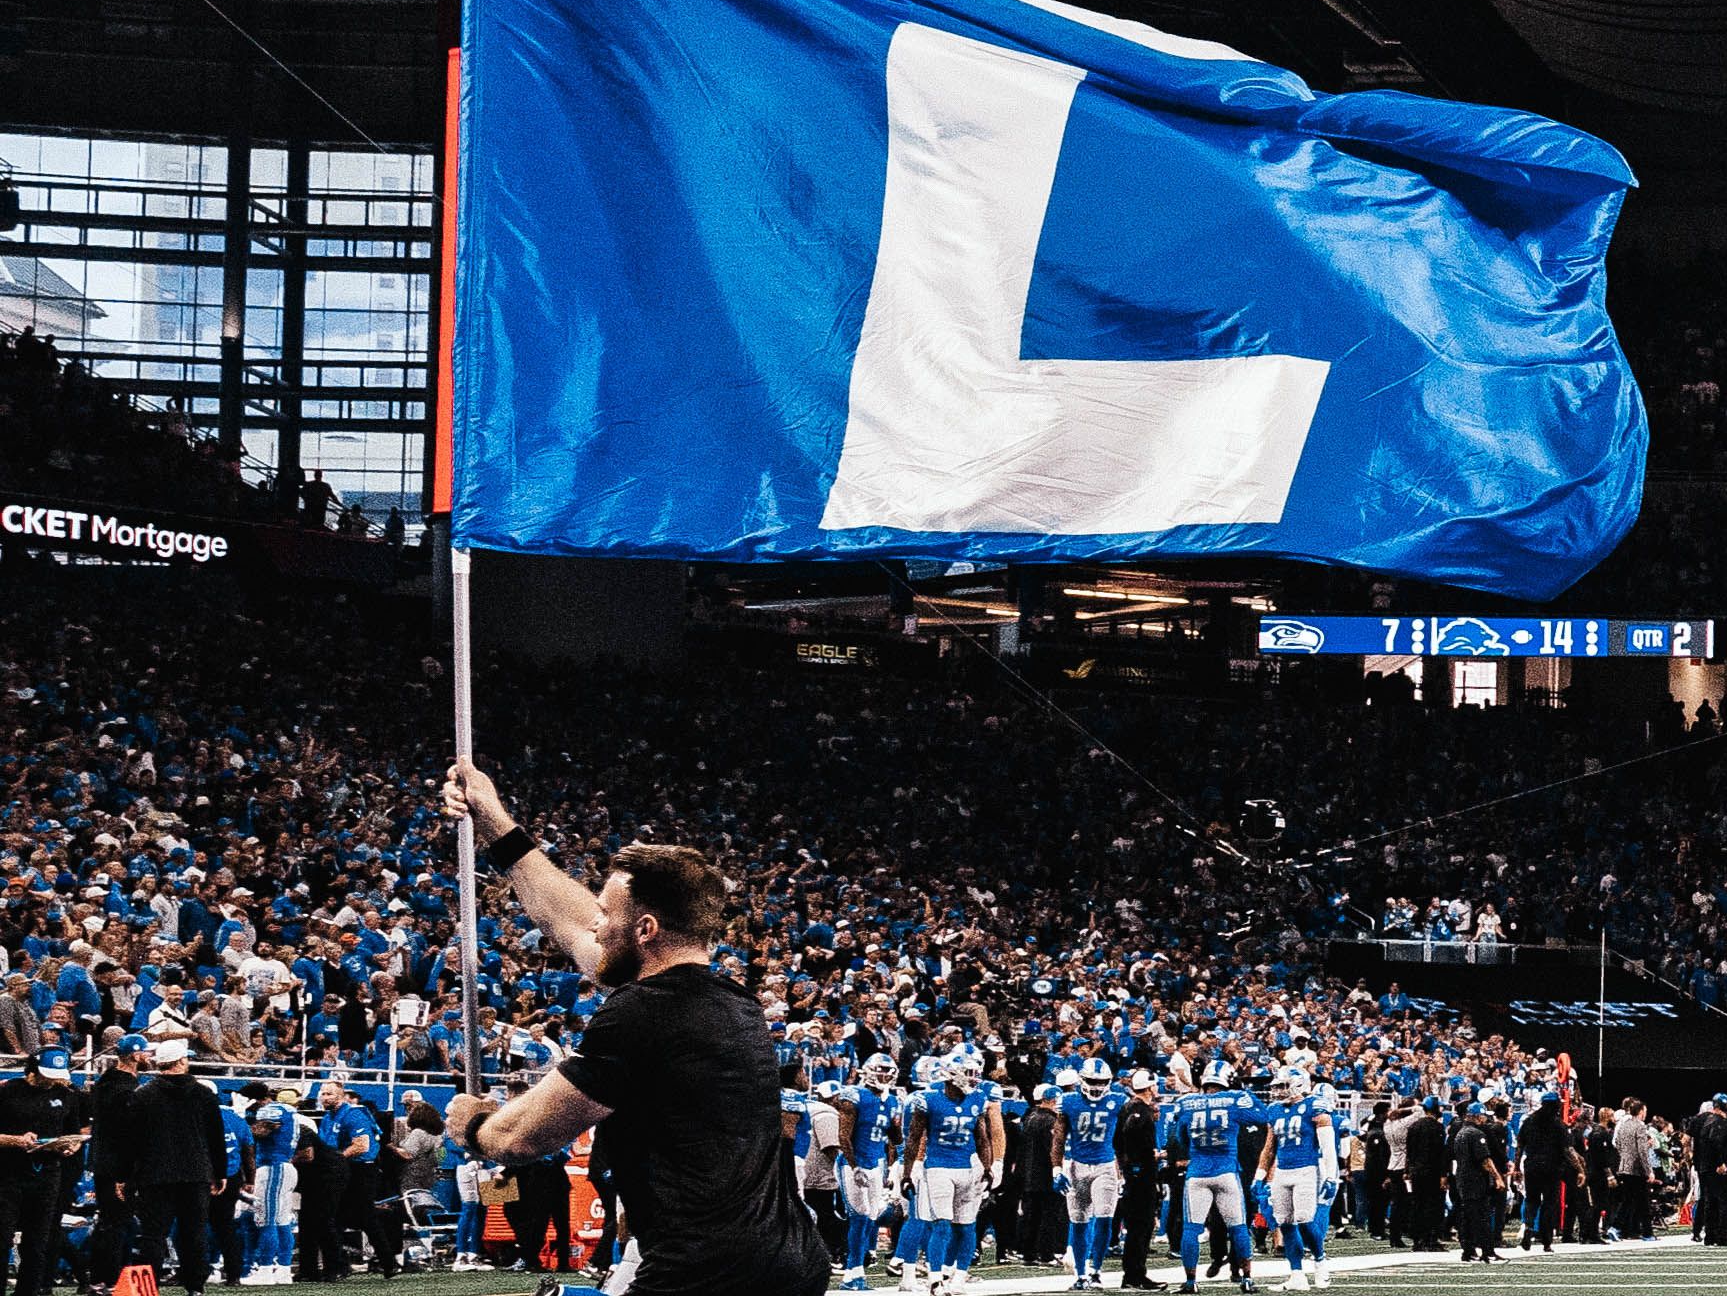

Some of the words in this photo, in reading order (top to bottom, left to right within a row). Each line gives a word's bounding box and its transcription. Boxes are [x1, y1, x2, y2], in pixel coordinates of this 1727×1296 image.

[824, 18, 1326, 533] L
[91, 514, 228, 563] Mortgage
[797, 643, 859, 659] EAGLE
[1382, 618, 1400, 653] 7
[1539, 620, 1574, 655] 14
[1632, 628, 1664, 650] QTR
[1673, 621, 1692, 657] 2
